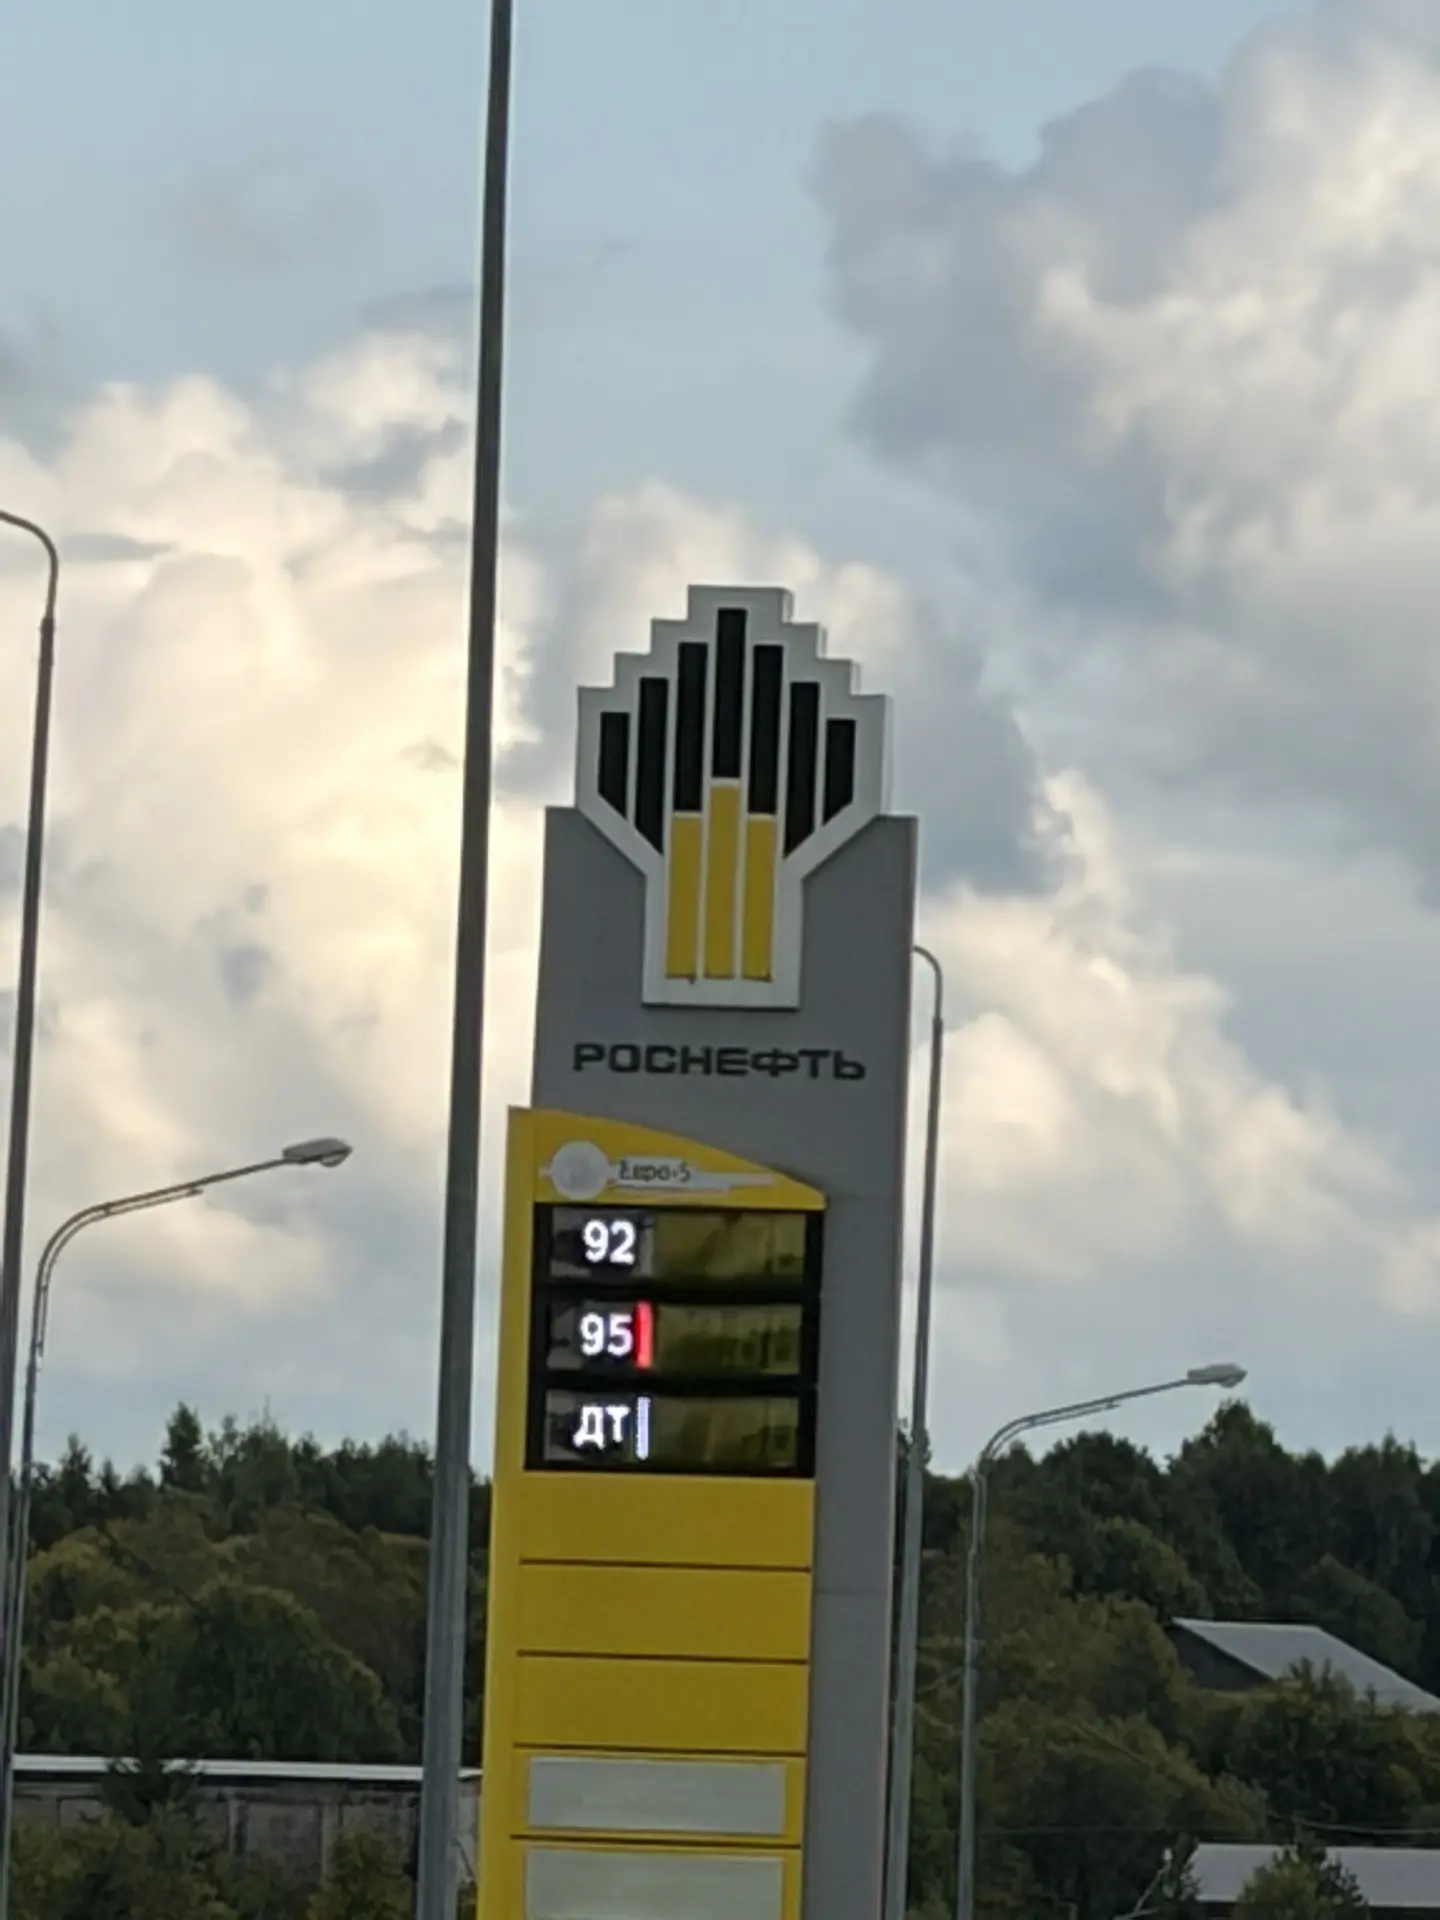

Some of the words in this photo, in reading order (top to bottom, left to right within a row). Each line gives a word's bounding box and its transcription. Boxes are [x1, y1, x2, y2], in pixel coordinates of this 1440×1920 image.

[573, 1042, 866, 1080] РОСНЕФТЬ
[582, 1219, 636, 1264] 92
[578, 1313, 634, 1356] 95
[572, 1404, 630, 1449] ДТ
